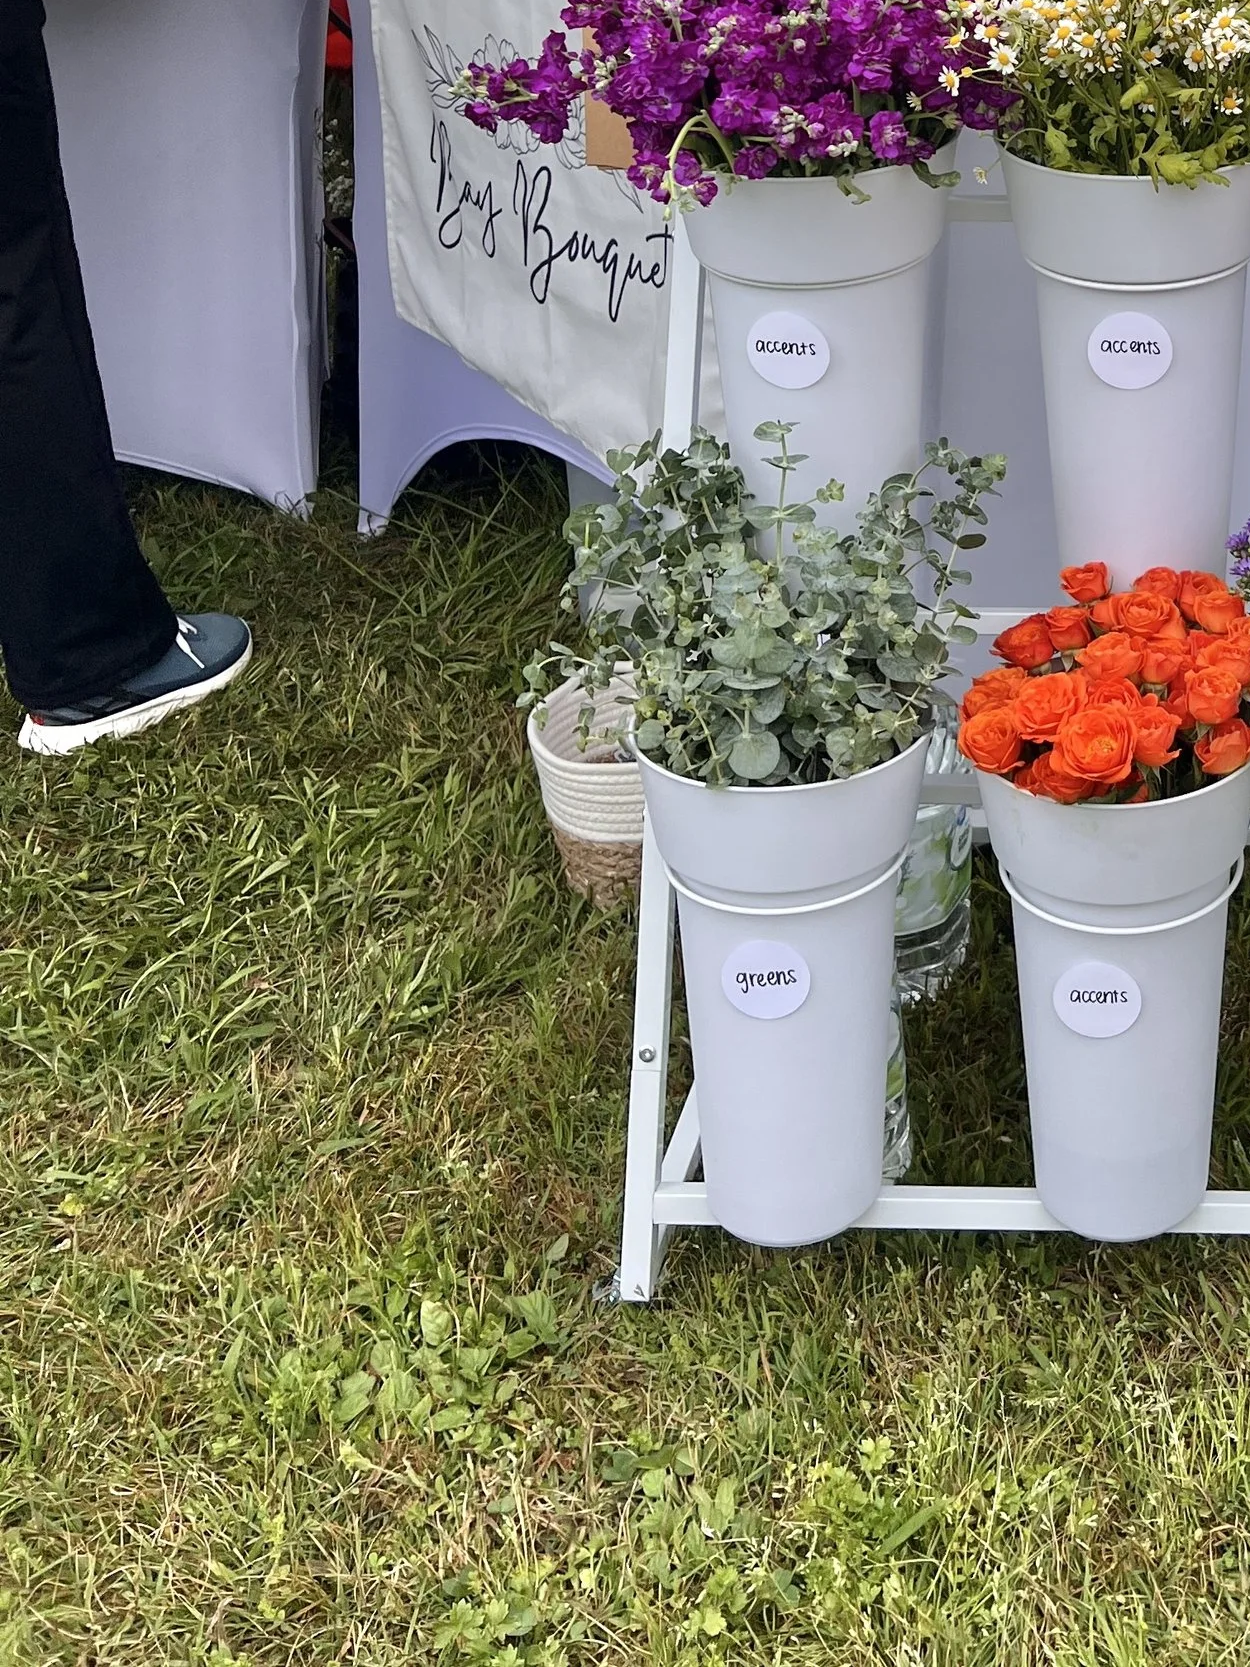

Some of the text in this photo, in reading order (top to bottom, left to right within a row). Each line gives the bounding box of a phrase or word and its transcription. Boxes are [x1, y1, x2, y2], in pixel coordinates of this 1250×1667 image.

[430, 110, 674, 323] Bay Bouquet
[755, 339, 817, 357] accents
[1100, 339, 1161, 356] accents
[735, 968, 798, 994] greens
[1069, 989, 1128, 1005] accents
